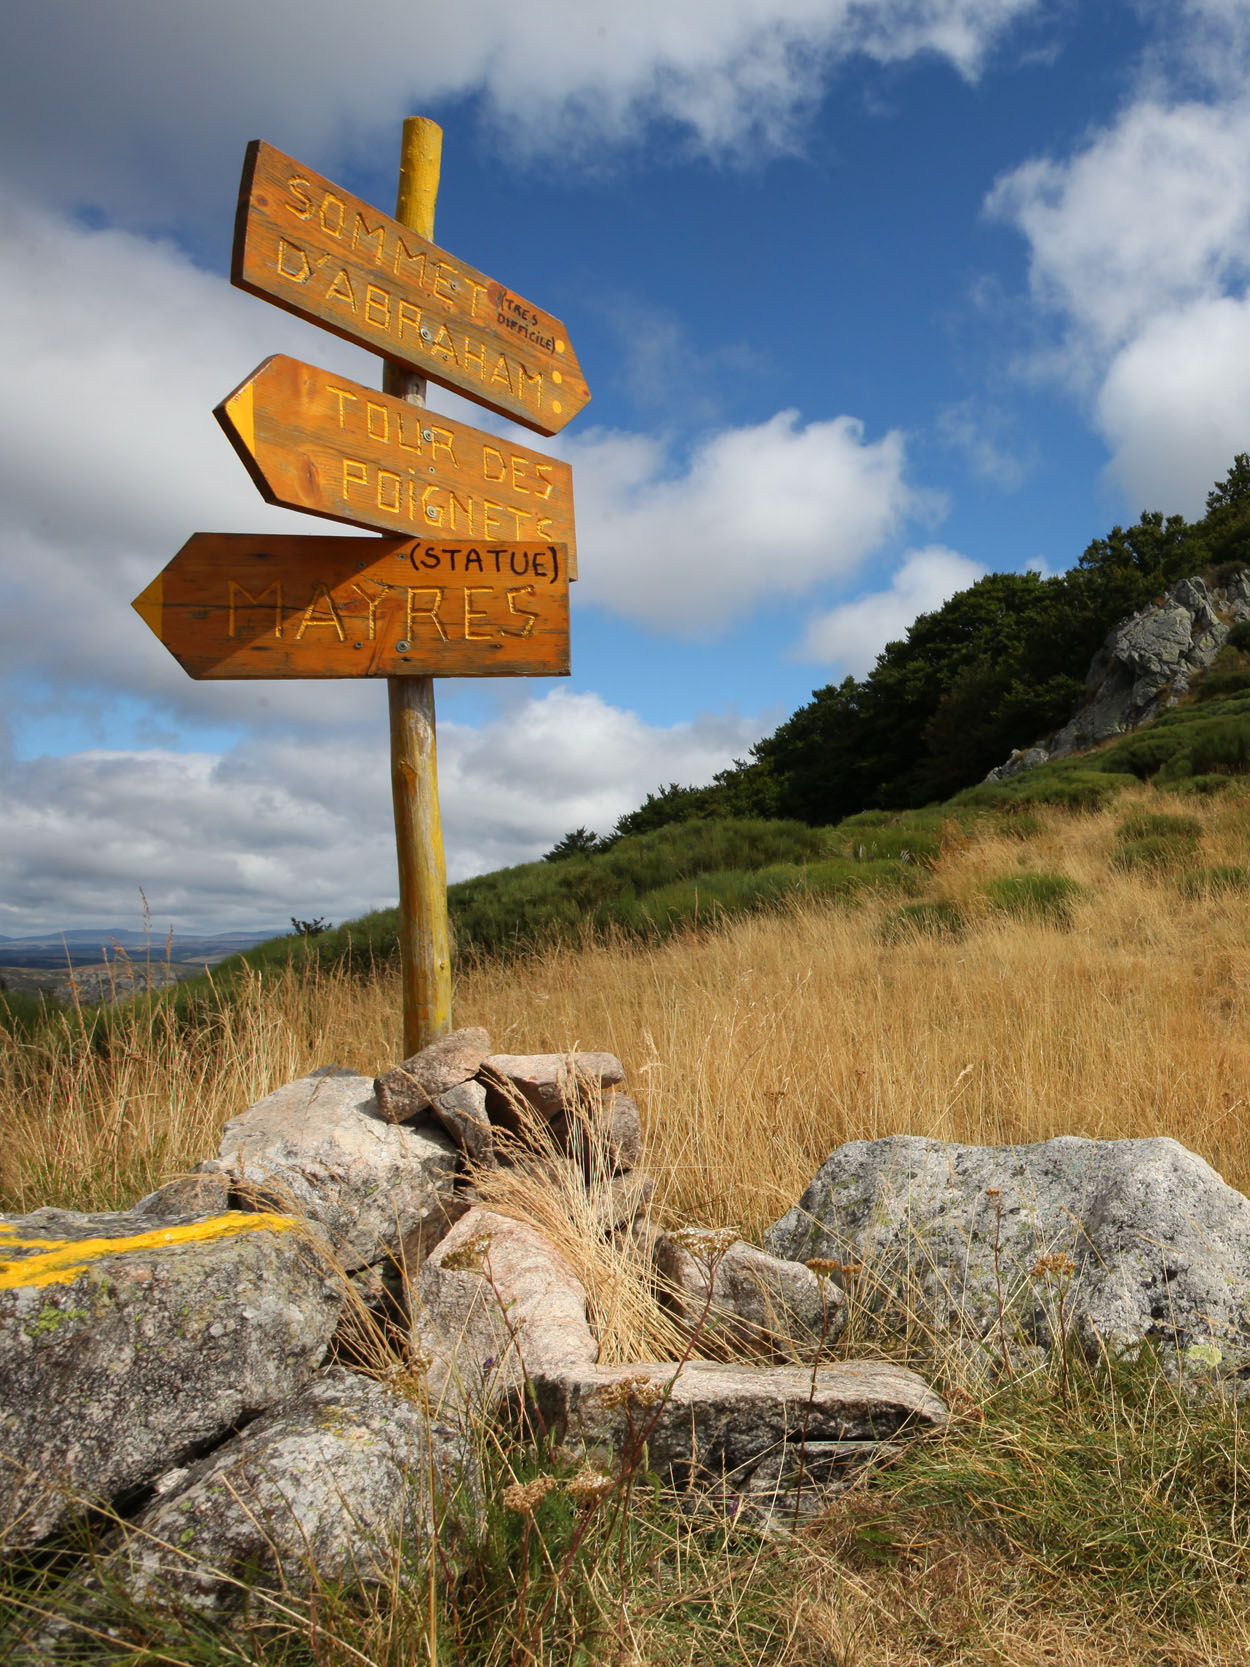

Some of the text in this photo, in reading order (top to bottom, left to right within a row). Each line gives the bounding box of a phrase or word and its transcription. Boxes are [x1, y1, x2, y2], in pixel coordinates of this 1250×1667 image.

[284, 174, 488, 318] SOMMET
[277, 236, 543, 409] D'ABRAHAM
[326, 384, 553, 500] TOUR DES
[343, 457, 553, 542] POIGNETS
[227, 578, 537, 642] MAYRES
[409, 542, 559, 584] (STATUE)
